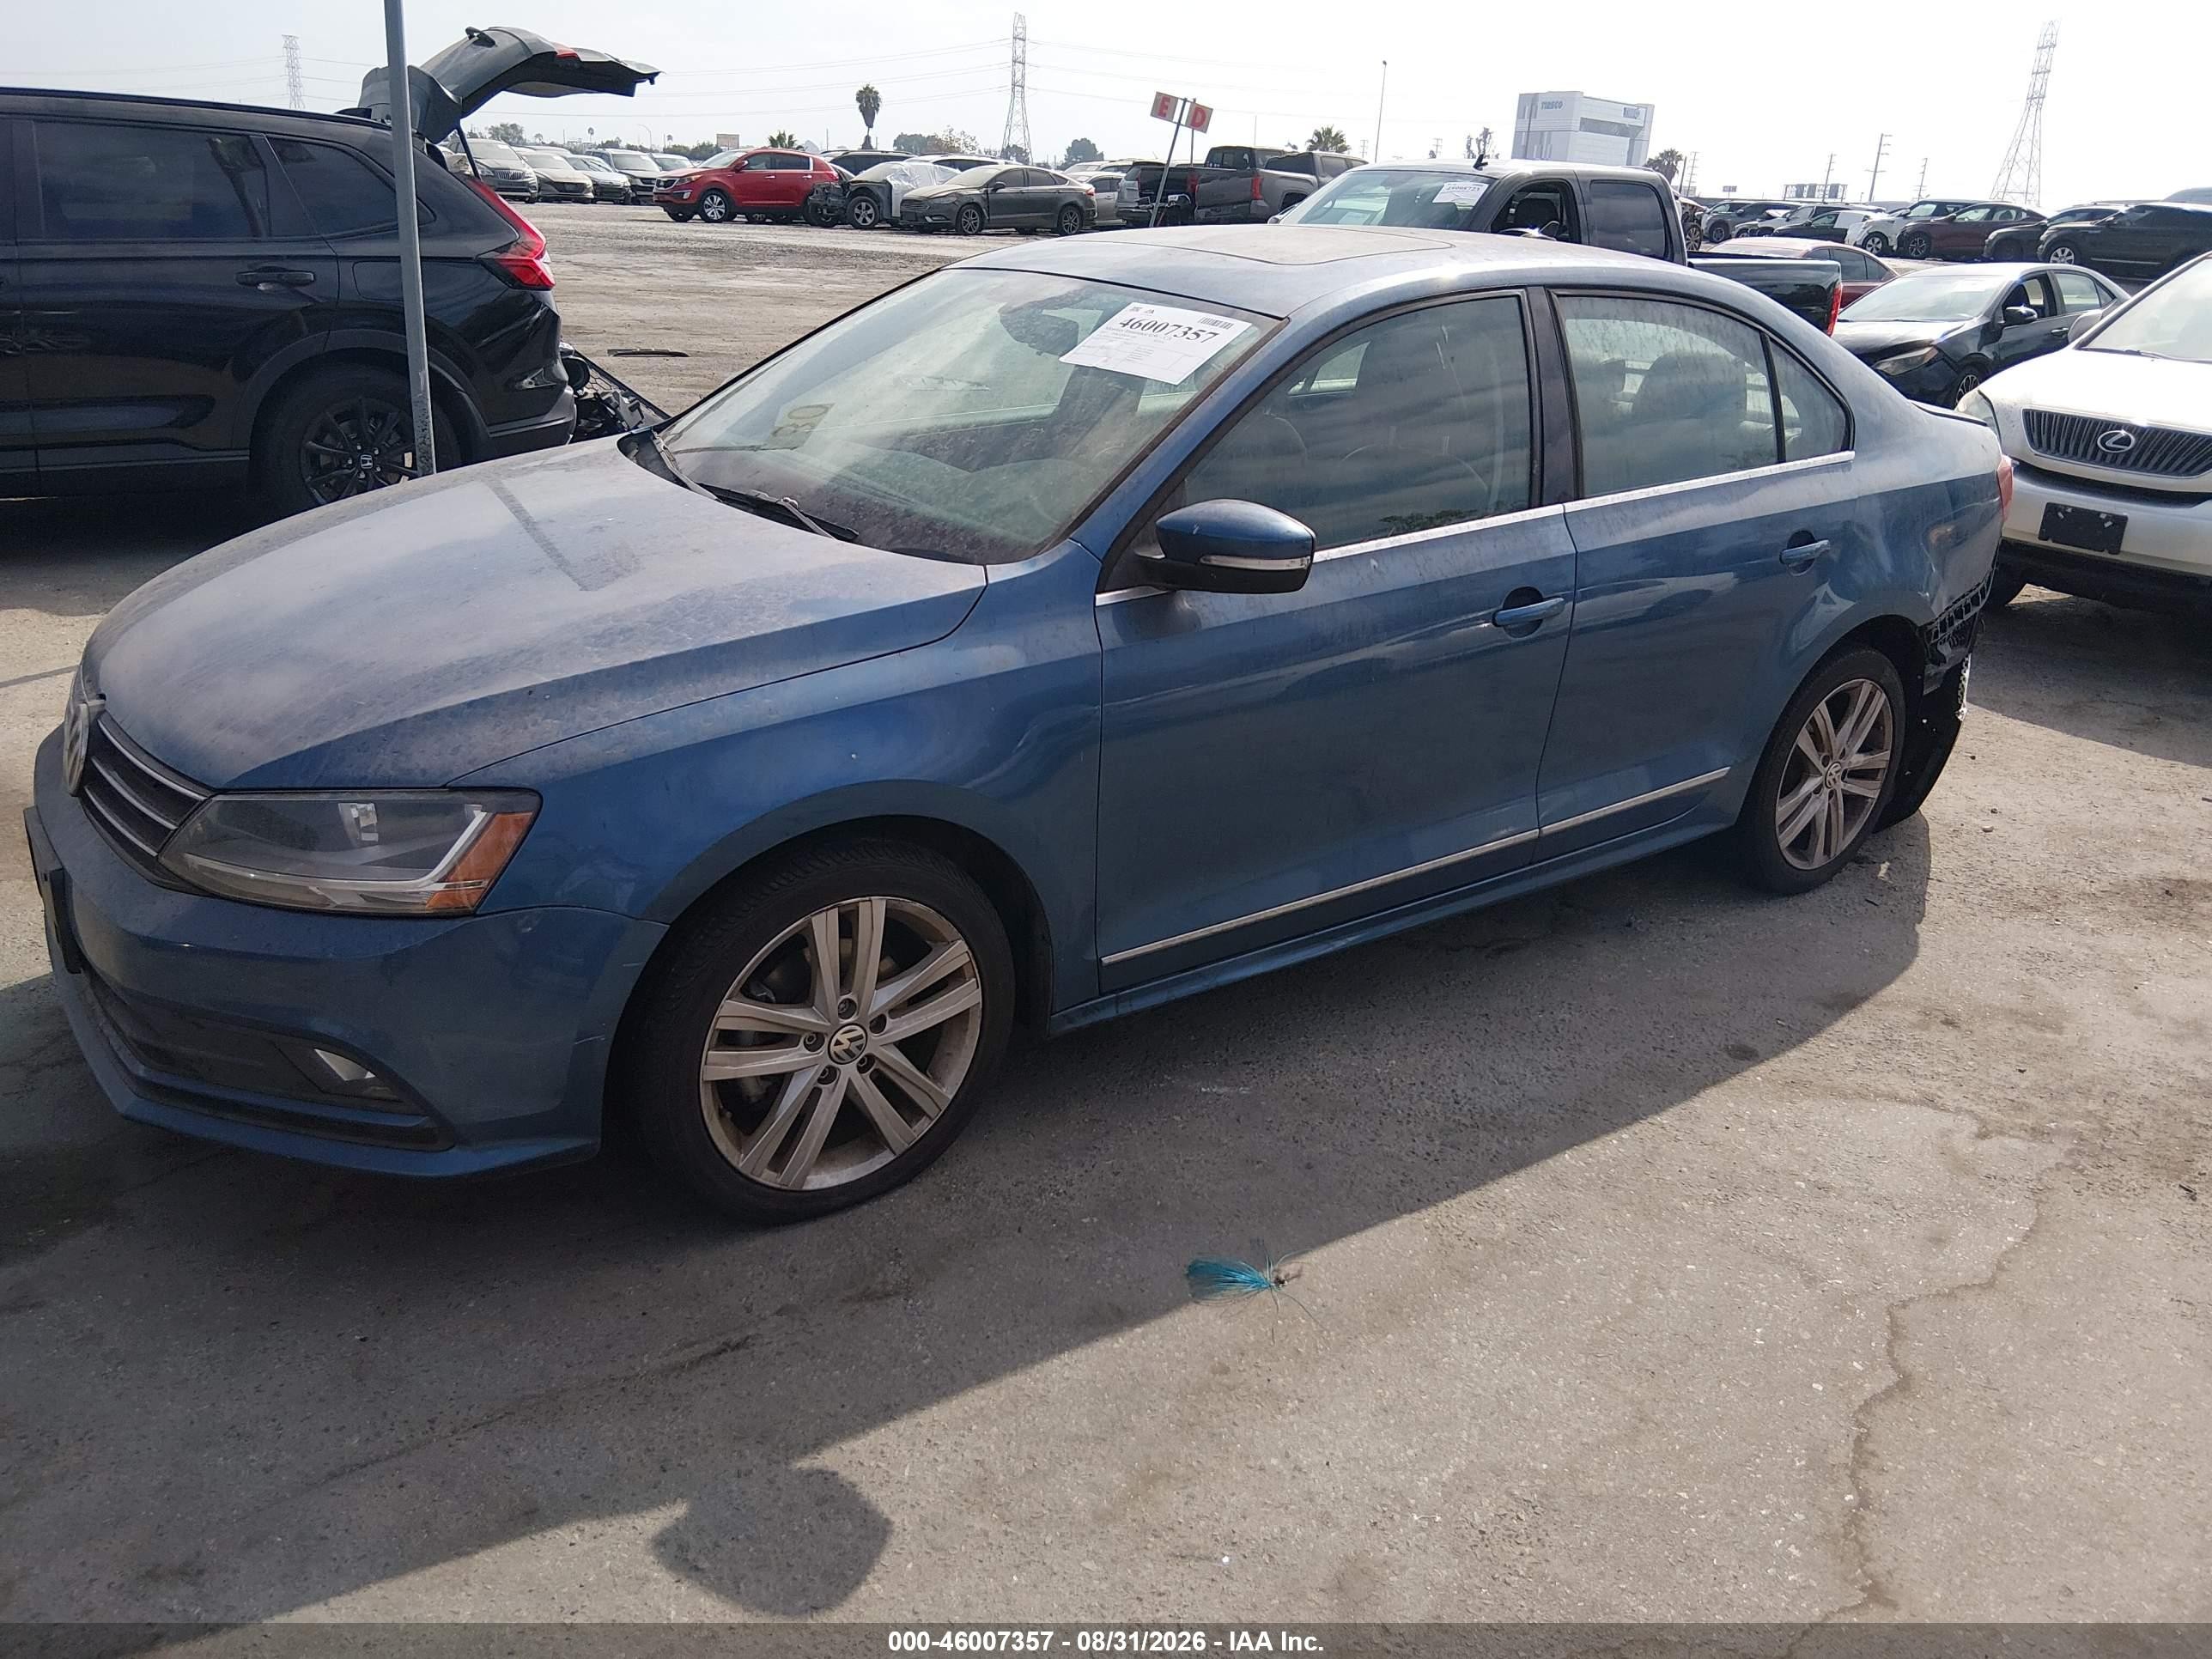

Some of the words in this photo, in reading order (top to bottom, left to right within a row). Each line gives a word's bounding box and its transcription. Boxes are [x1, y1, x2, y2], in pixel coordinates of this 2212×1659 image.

[1157, 95, 1171, 118] E
[1190, 106, 1206, 128] D
[1118, 317, 1220, 343] 46007357
